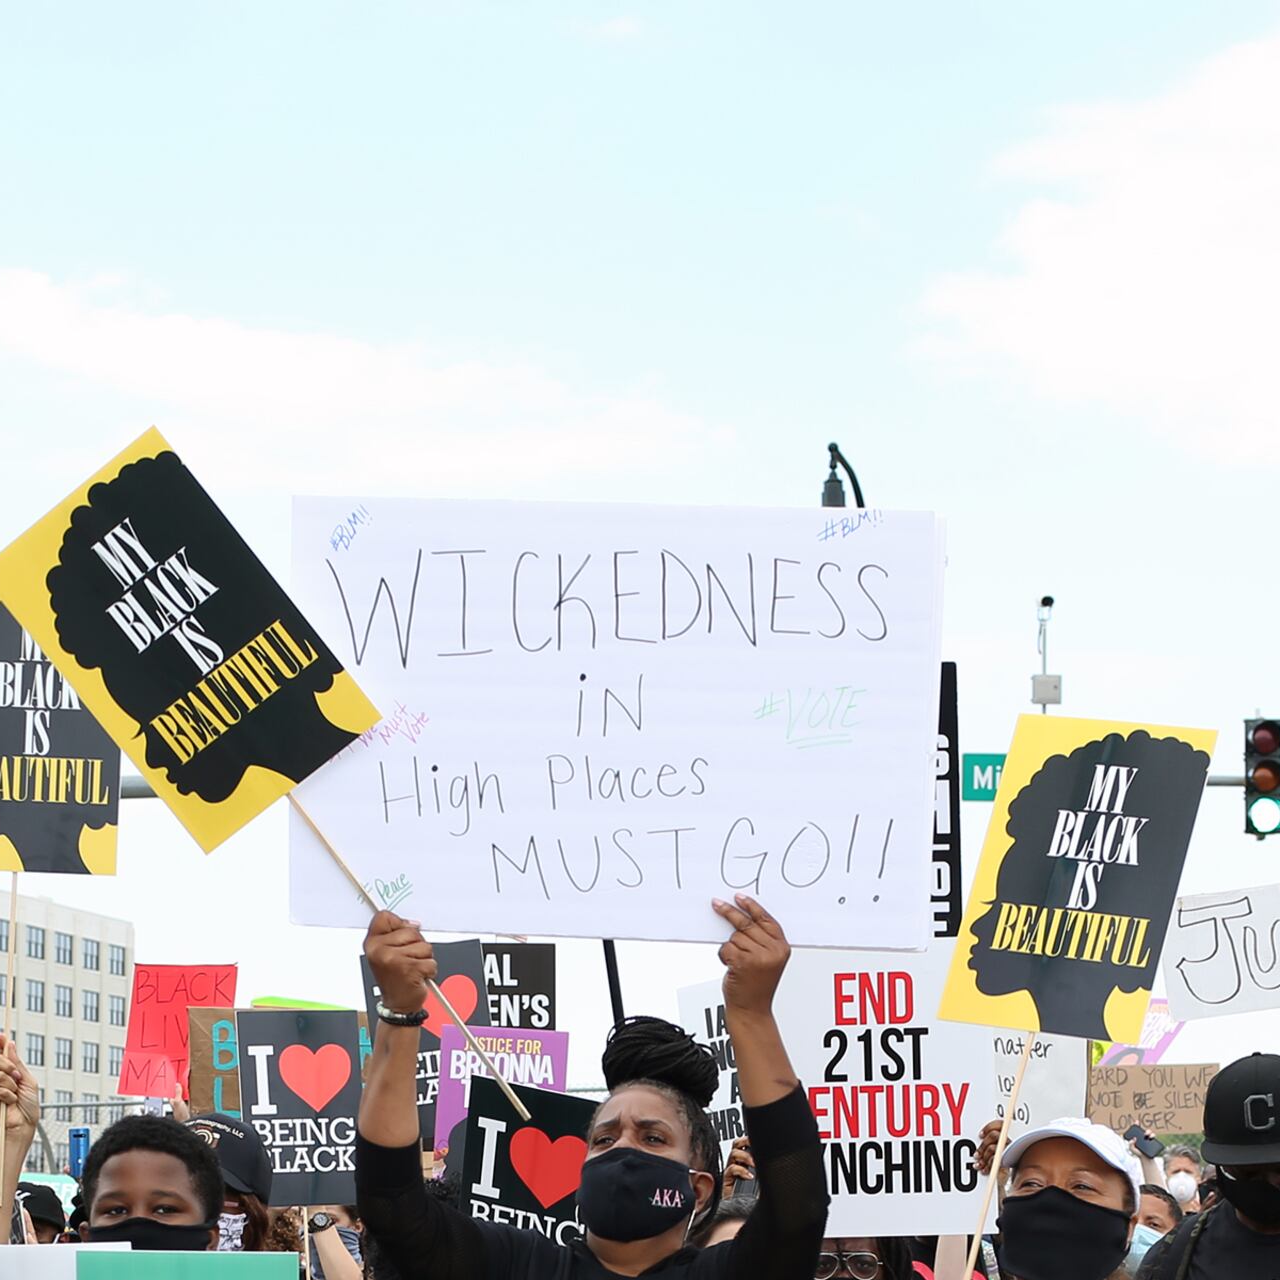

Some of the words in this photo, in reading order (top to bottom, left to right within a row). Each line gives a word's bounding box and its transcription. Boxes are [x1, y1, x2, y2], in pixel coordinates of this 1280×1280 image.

[91, 517, 159, 592] MY
[105, 546, 220, 654] BLACK
[325, 548, 889, 669] WICKEDNESS
[169, 616, 225, 677] IS
[148, 618, 320, 767] BEAUTIFUL
[23, 709, 51, 756] IS
[379, 757, 505, 837] High
[546, 753, 709, 811] Places
[1083, 763, 1139, 815] MY
[490, 825, 696, 900] MUST
[720, 814, 894, 906] GO!!
[1046, 809, 1150, 866] BLACK
[1065, 860, 1106, 911] IS
[989, 900, 1151, 969] BEAUTIFUL
[136, 970, 233, 1005] BLACK
[834, 971, 914, 1026] END
[516, 1039, 542, 1055] FOR
[824, 1028, 928, 1082] 21ST
[247, 1045, 278, 1115] I
[251, 1117, 356, 1149] BEING
[471, 1116, 506, 1200] I
